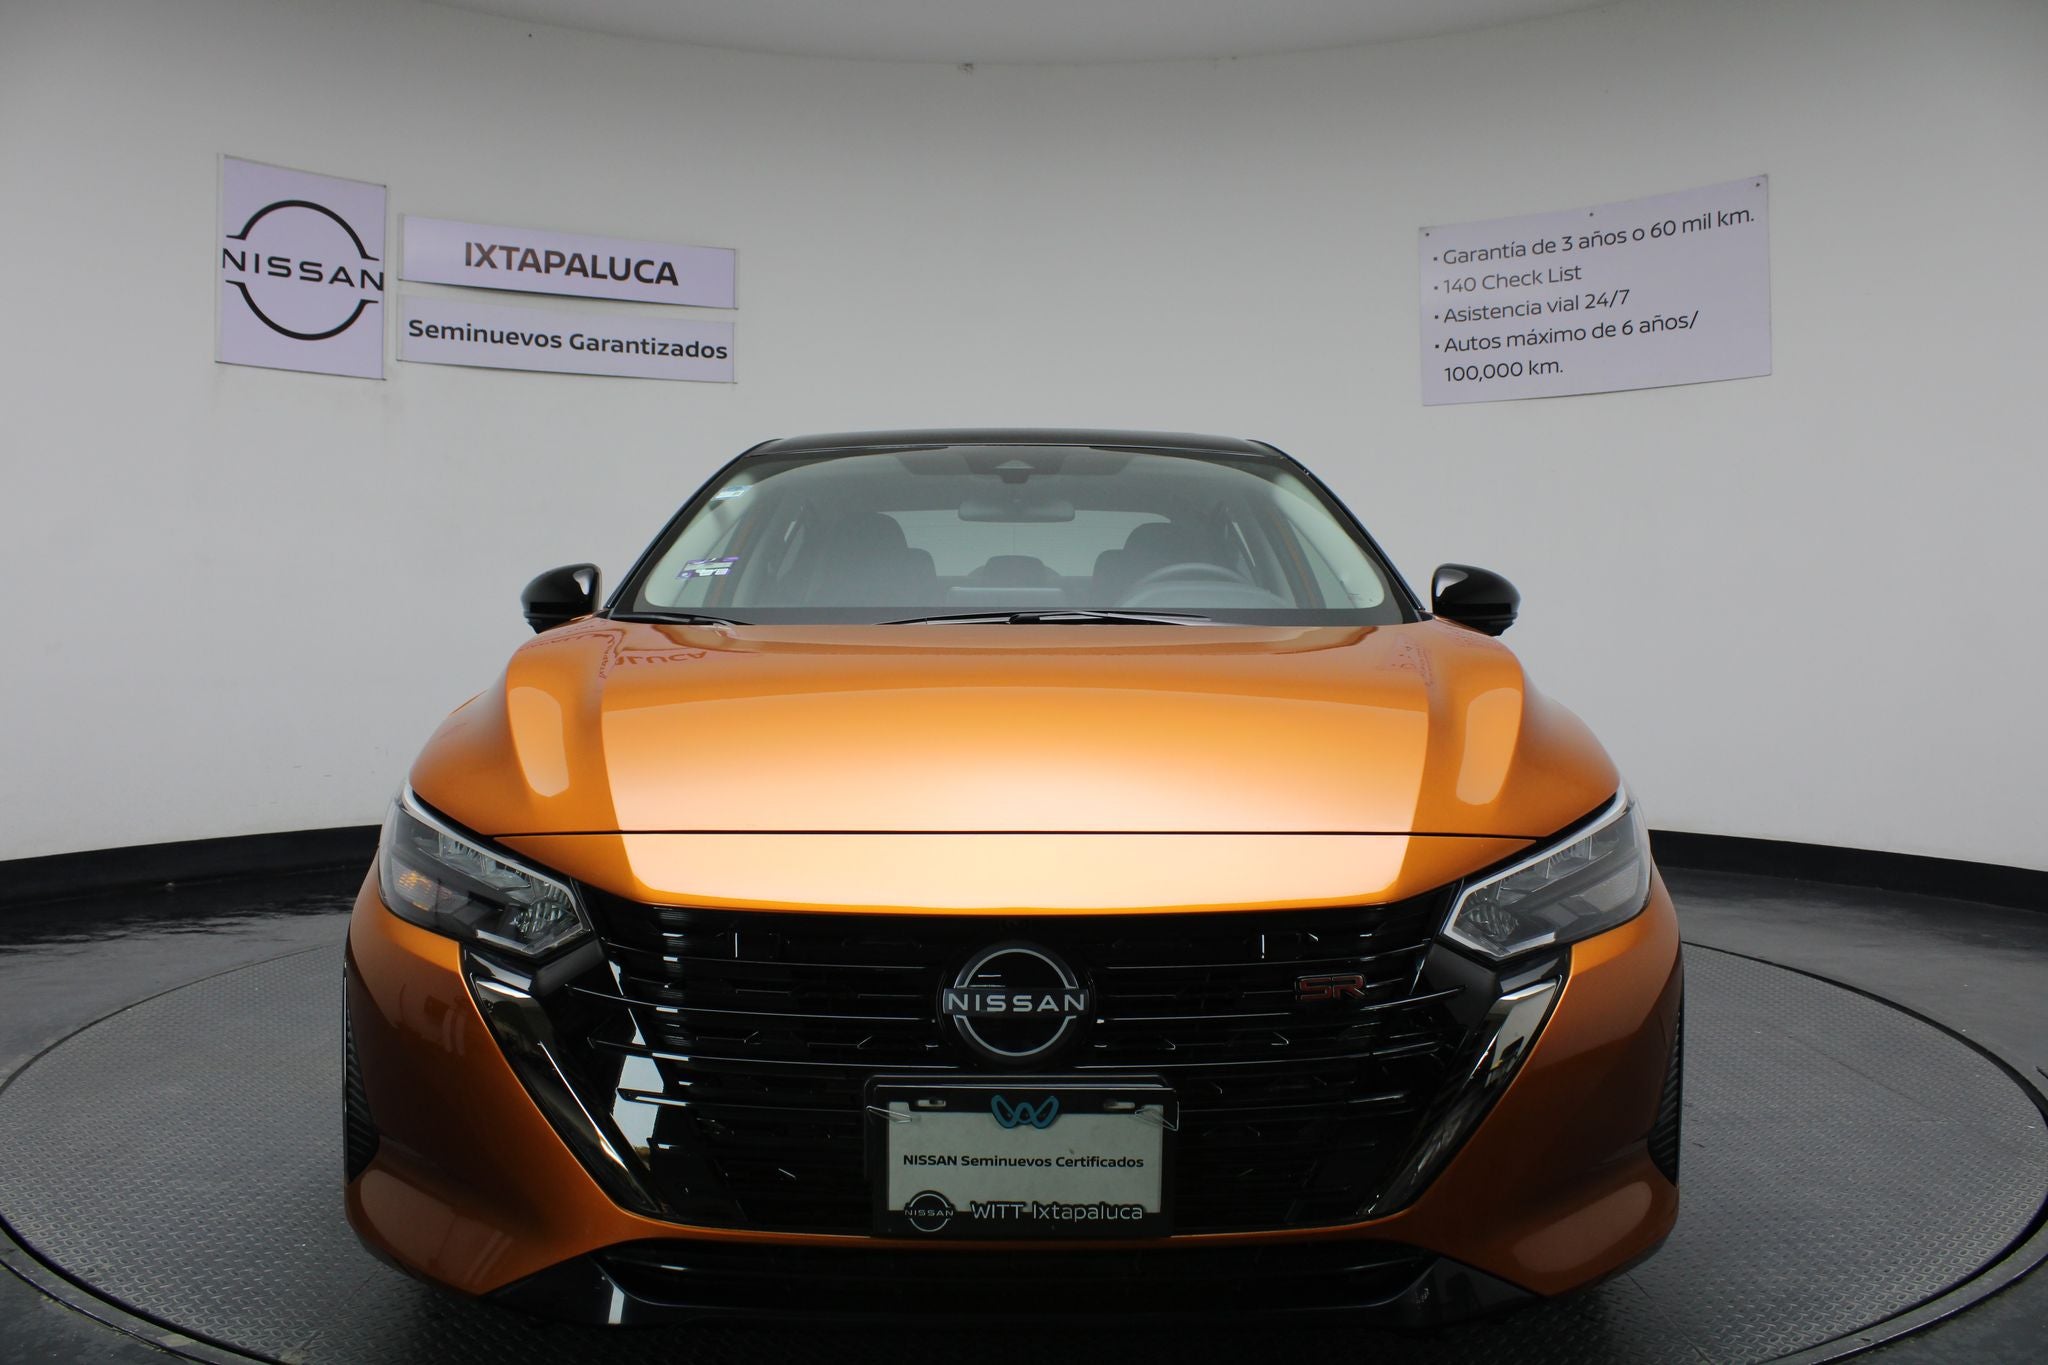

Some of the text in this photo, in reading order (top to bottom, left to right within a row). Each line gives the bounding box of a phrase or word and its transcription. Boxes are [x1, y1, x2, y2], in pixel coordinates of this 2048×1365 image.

[1443, 208, 1754, 265] Garantía de 3 años o 60 mil km.
[222, 247, 384, 291] NISSAN
[465, 241, 679, 286] IXTAPALUCA
[1444, 265, 1582, 293] 140 Check List
[1444, 289, 1630, 323] Asistencia vial 24/7
[409, 319, 728, 360] Seminuevos Garantizados
[1444, 311, 1699, 352] Autos máximo de 6 años/
[1444, 360, 1563, 383] 100,000 km.
[1299, 976, 1365, 1000] SR
[948, 993, 1086, 1013] NISSAN
[904, 1155, 1144, 1168] NISSAN Seminuevos Certificados
[904, 1208, 954, 1217] NISSAN
[970, 1204, 1143, 1223] WITT Ixtapaluca
